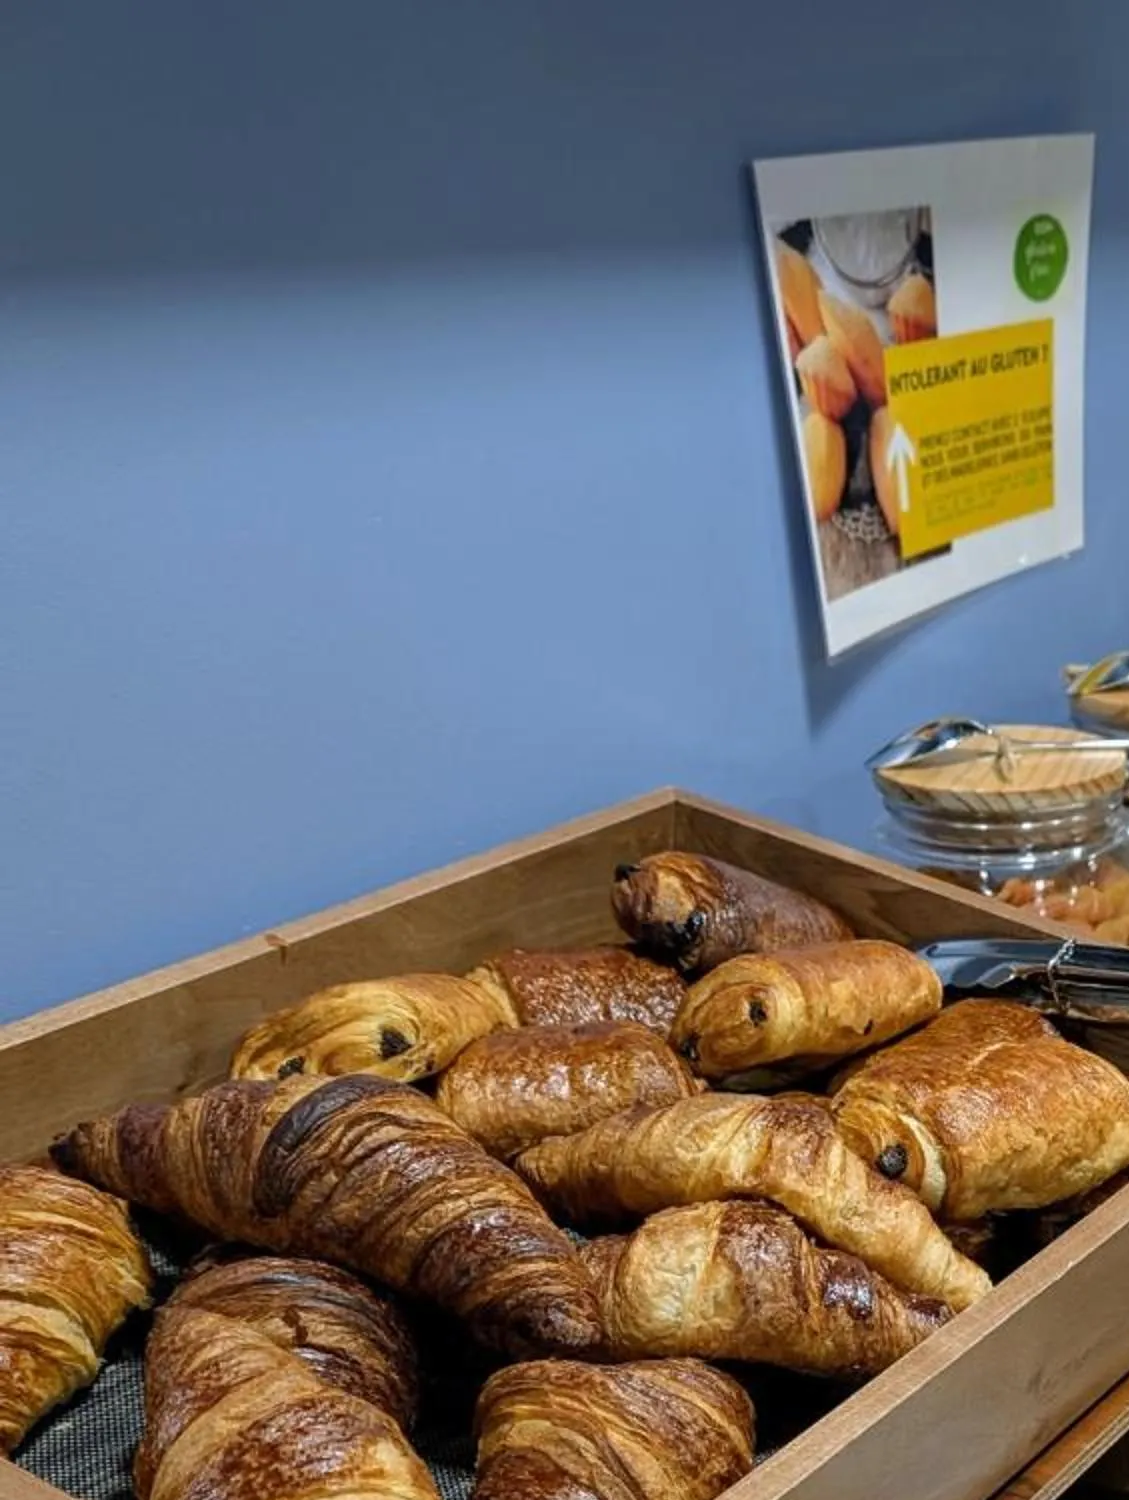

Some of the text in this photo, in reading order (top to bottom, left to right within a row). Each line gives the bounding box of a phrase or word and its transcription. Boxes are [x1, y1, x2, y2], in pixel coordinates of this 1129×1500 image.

[889, 360, 967, 395] INTOLERANT
[971, 355, 988, 377] AU
[990, 346, 1039, 374] GLUTEN
